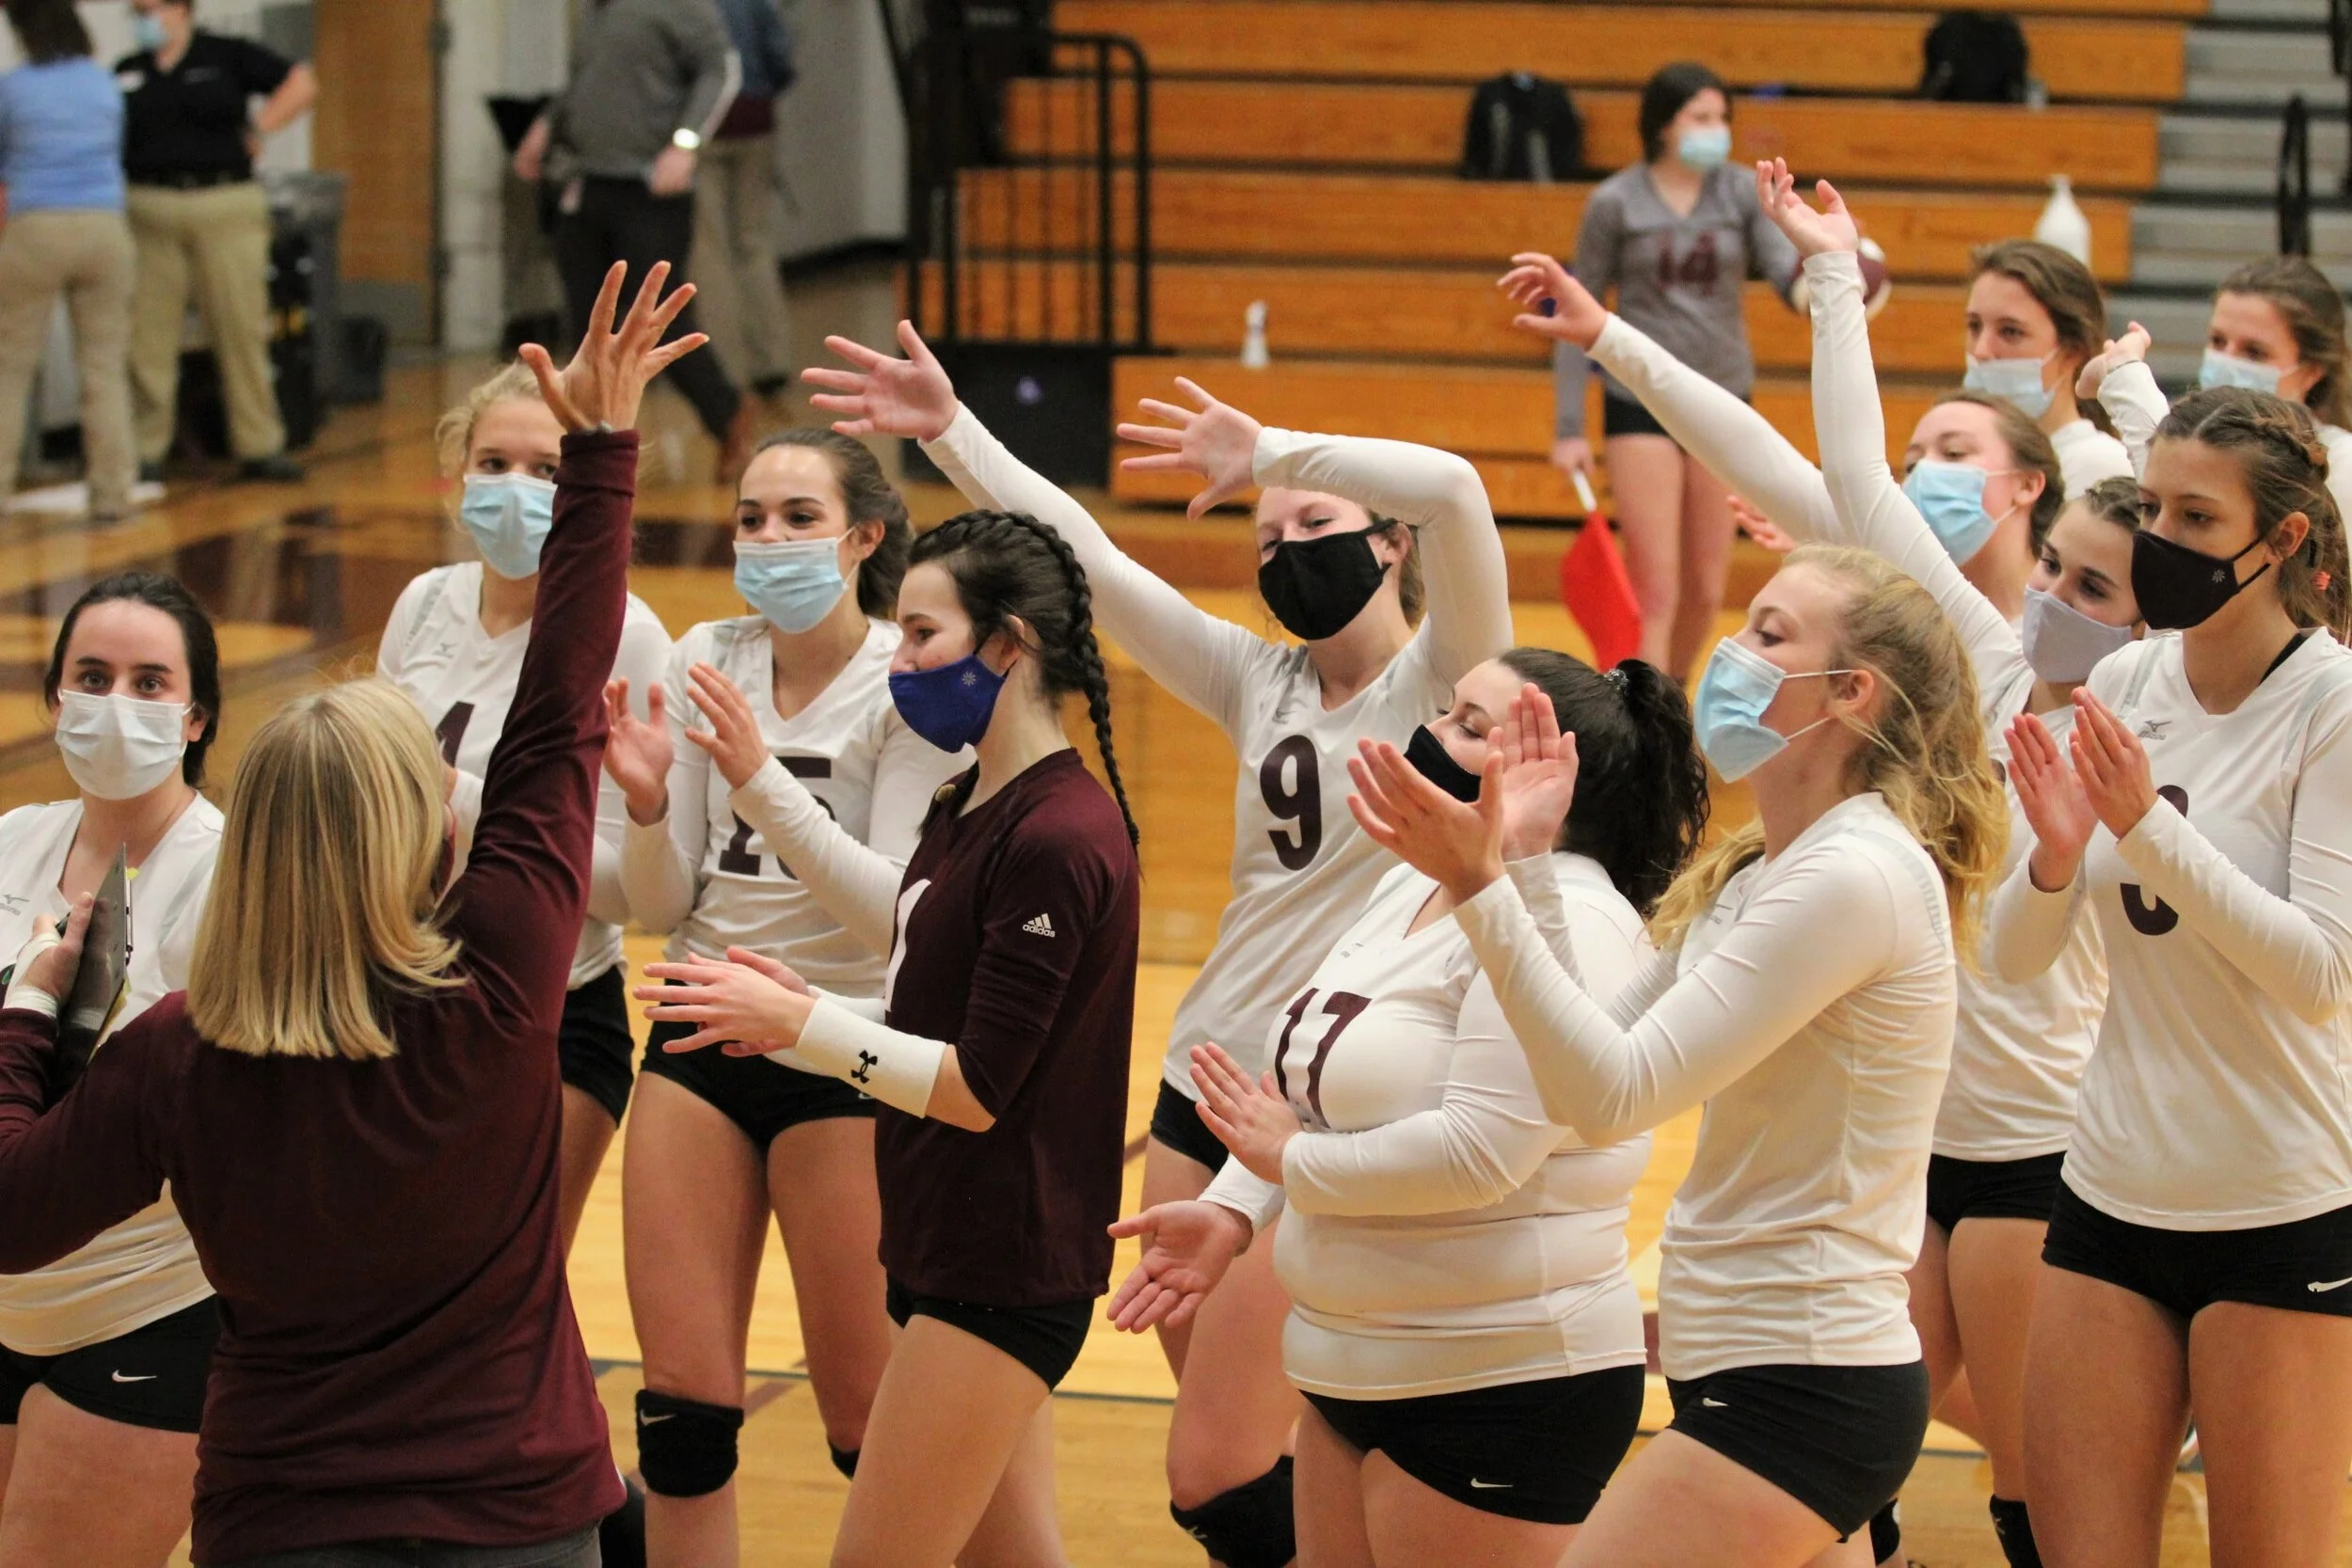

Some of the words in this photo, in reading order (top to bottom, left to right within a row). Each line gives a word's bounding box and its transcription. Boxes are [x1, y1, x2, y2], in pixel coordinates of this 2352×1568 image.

[1260, 735, 1322, 871] 9
[1022, 924, 1056, 938] adidas
[1274, 987, 1373, 1130] 17
